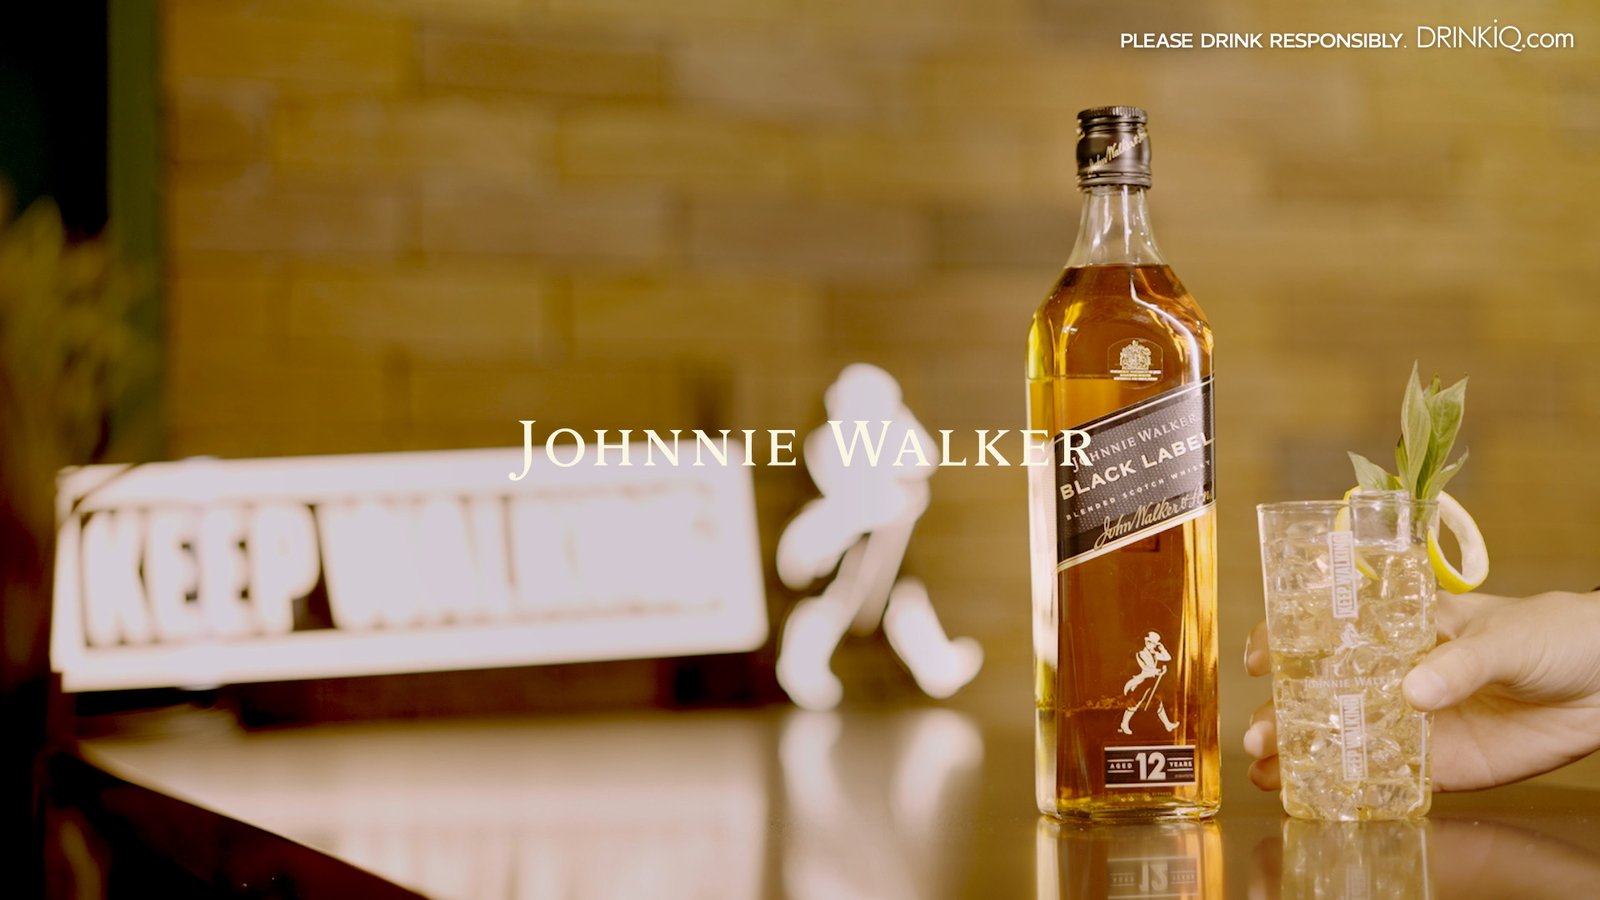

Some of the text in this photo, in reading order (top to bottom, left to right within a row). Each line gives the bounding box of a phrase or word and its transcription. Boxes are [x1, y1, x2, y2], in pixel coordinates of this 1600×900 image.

[1138, 414, 1198, 443] WALKER
[1060, 432, 1214, 500] BLACK LABEL
[1065, 497, 1115, 521] BLENDED
[1123, 478, 1164, 498] SCOTCH
[1094, 515, 1134, 552] John
[1130, 497, 1180, 529] Walker
[82, 488, 726, 648] KEEP WALK
[1135, 751, 1167, 780] 12
[1169, 760, 1193, 768] YEARS
